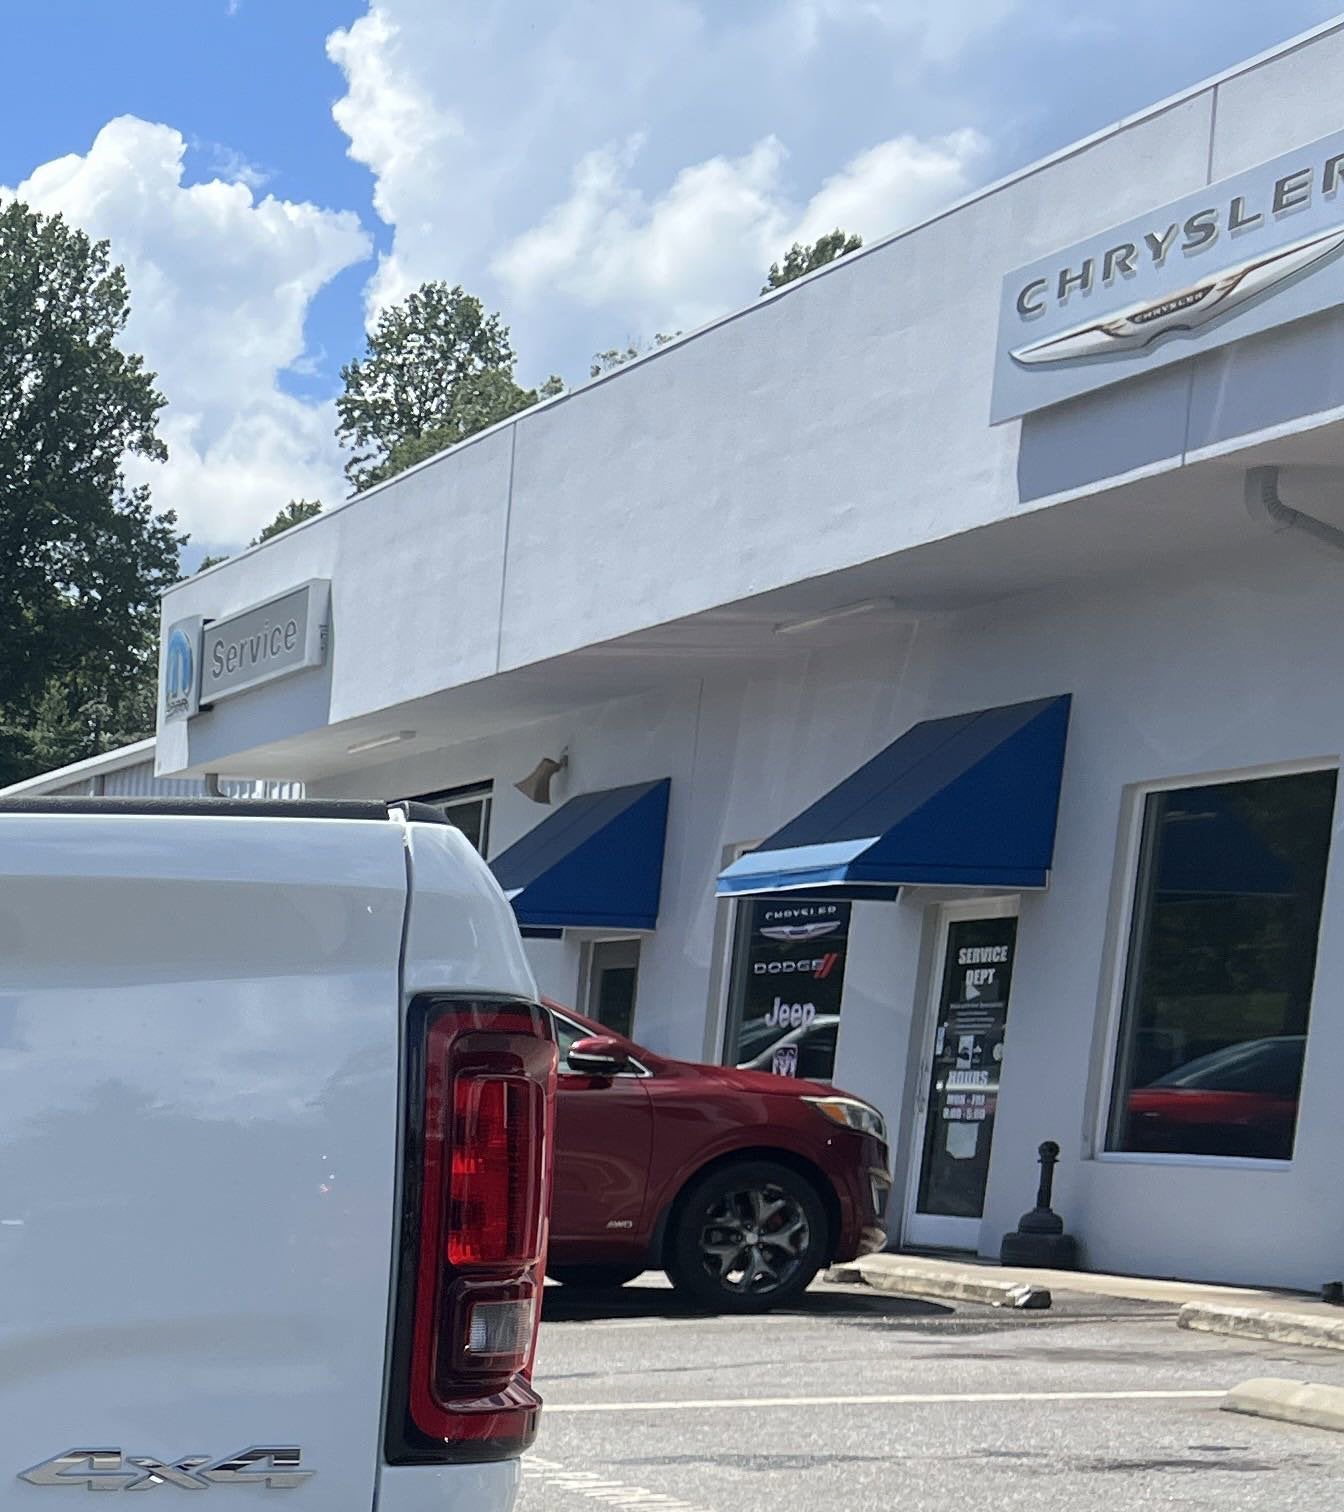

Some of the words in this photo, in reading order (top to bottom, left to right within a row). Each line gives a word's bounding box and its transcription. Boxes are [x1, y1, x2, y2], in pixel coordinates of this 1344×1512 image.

[212, 618, 297, 679] Service
[958, 946, 1008, 965] SERVICE
[965, 968, 996, 986] DEPT
[765, 997, 816, 1031] Jeep
[947, 1070, 989, 1086] HOURS
